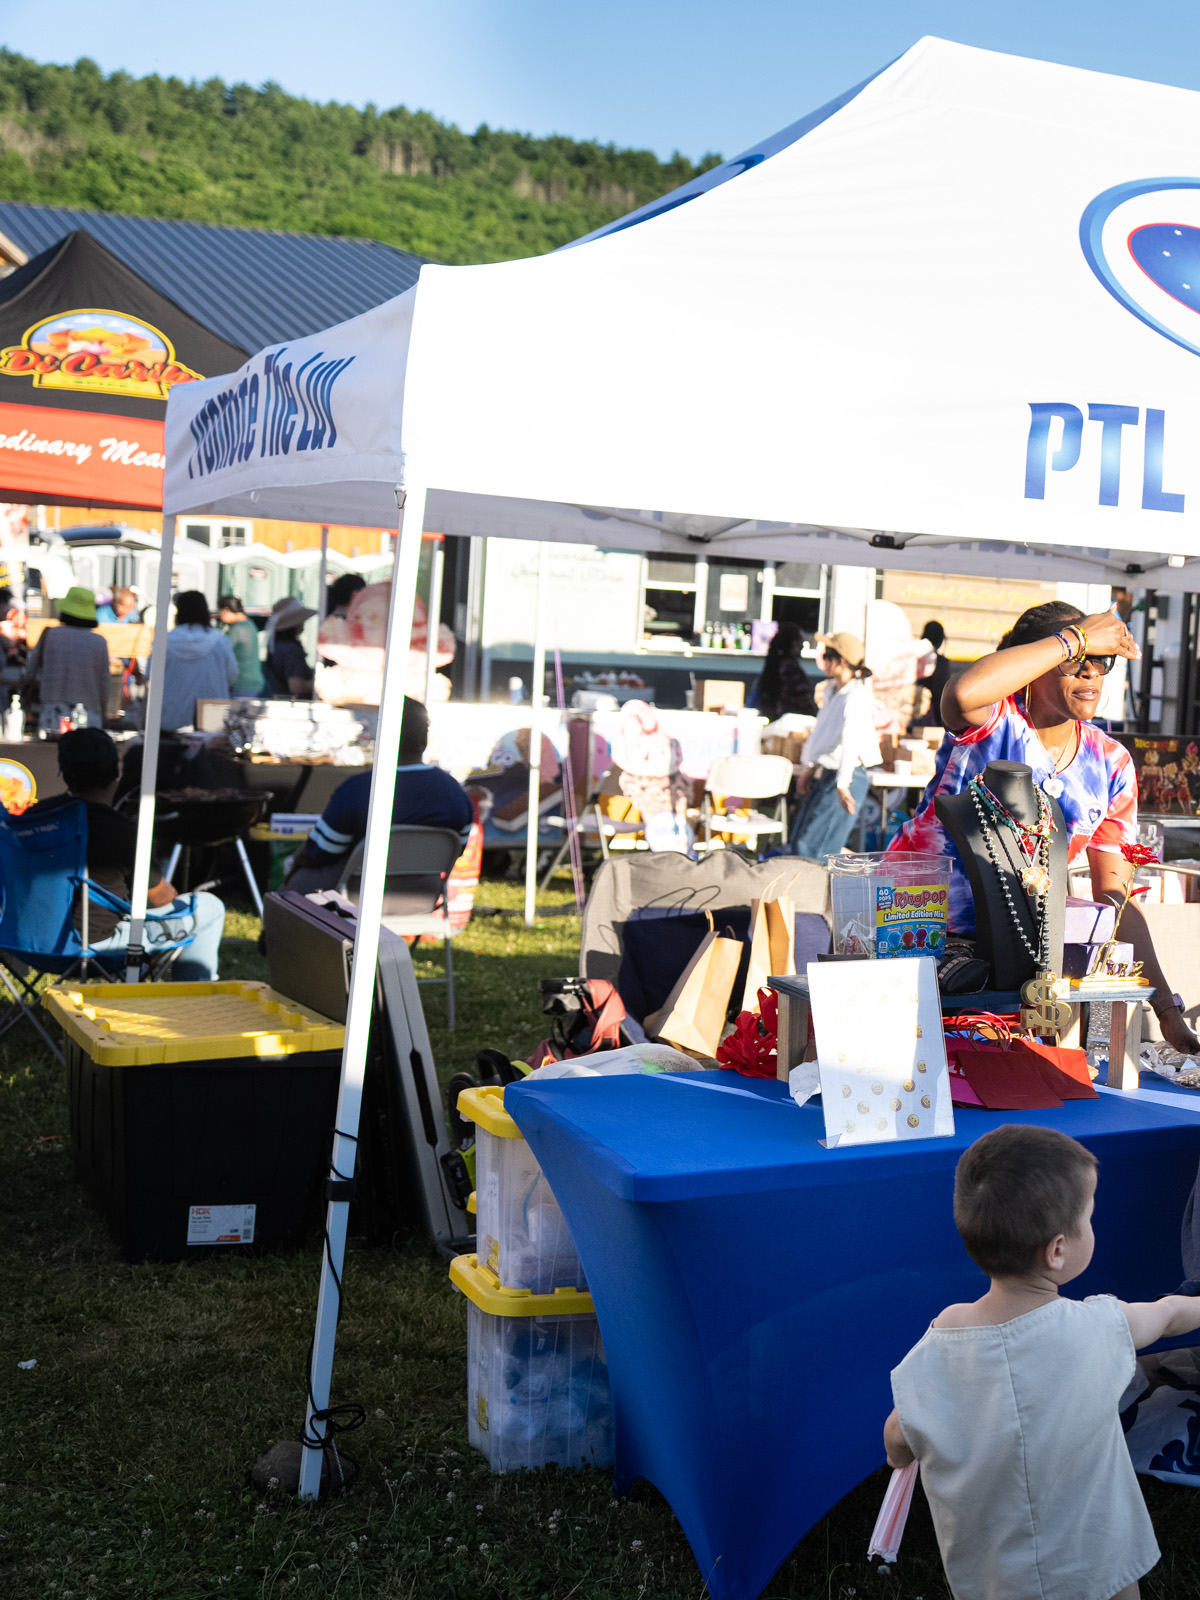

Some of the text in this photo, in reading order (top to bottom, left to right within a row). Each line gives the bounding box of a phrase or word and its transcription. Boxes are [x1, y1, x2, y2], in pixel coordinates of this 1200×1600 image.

[260, 347, 299, 458] The
[99, 437, 166, 470] Mea
[1024, 402, 1185, 513] PTL
[884, 910, 945, 922] Limited Edition Mix
